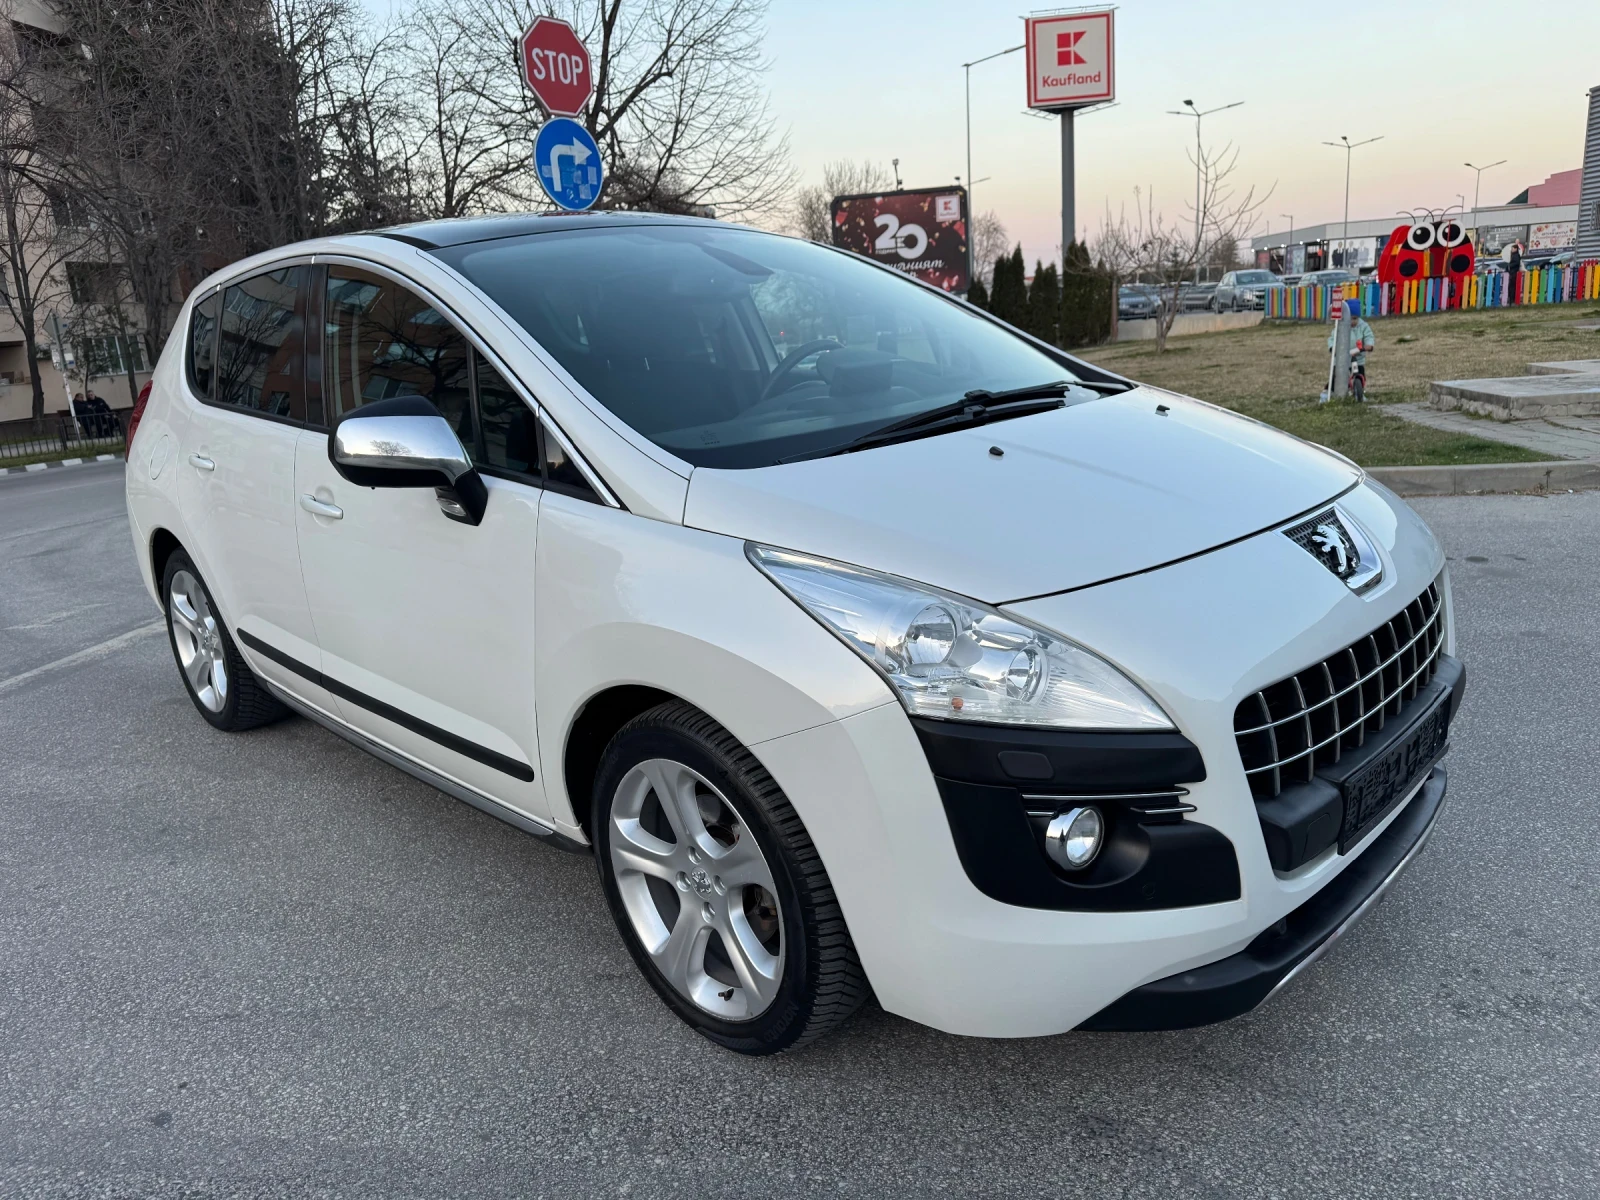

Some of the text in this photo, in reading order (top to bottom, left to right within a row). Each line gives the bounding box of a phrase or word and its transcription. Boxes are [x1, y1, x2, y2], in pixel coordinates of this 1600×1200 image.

[531, 47, 583, 86] STOP
[1042, 70, 1101, 88] Kaufland
[873, 213, 928, 260] 20
